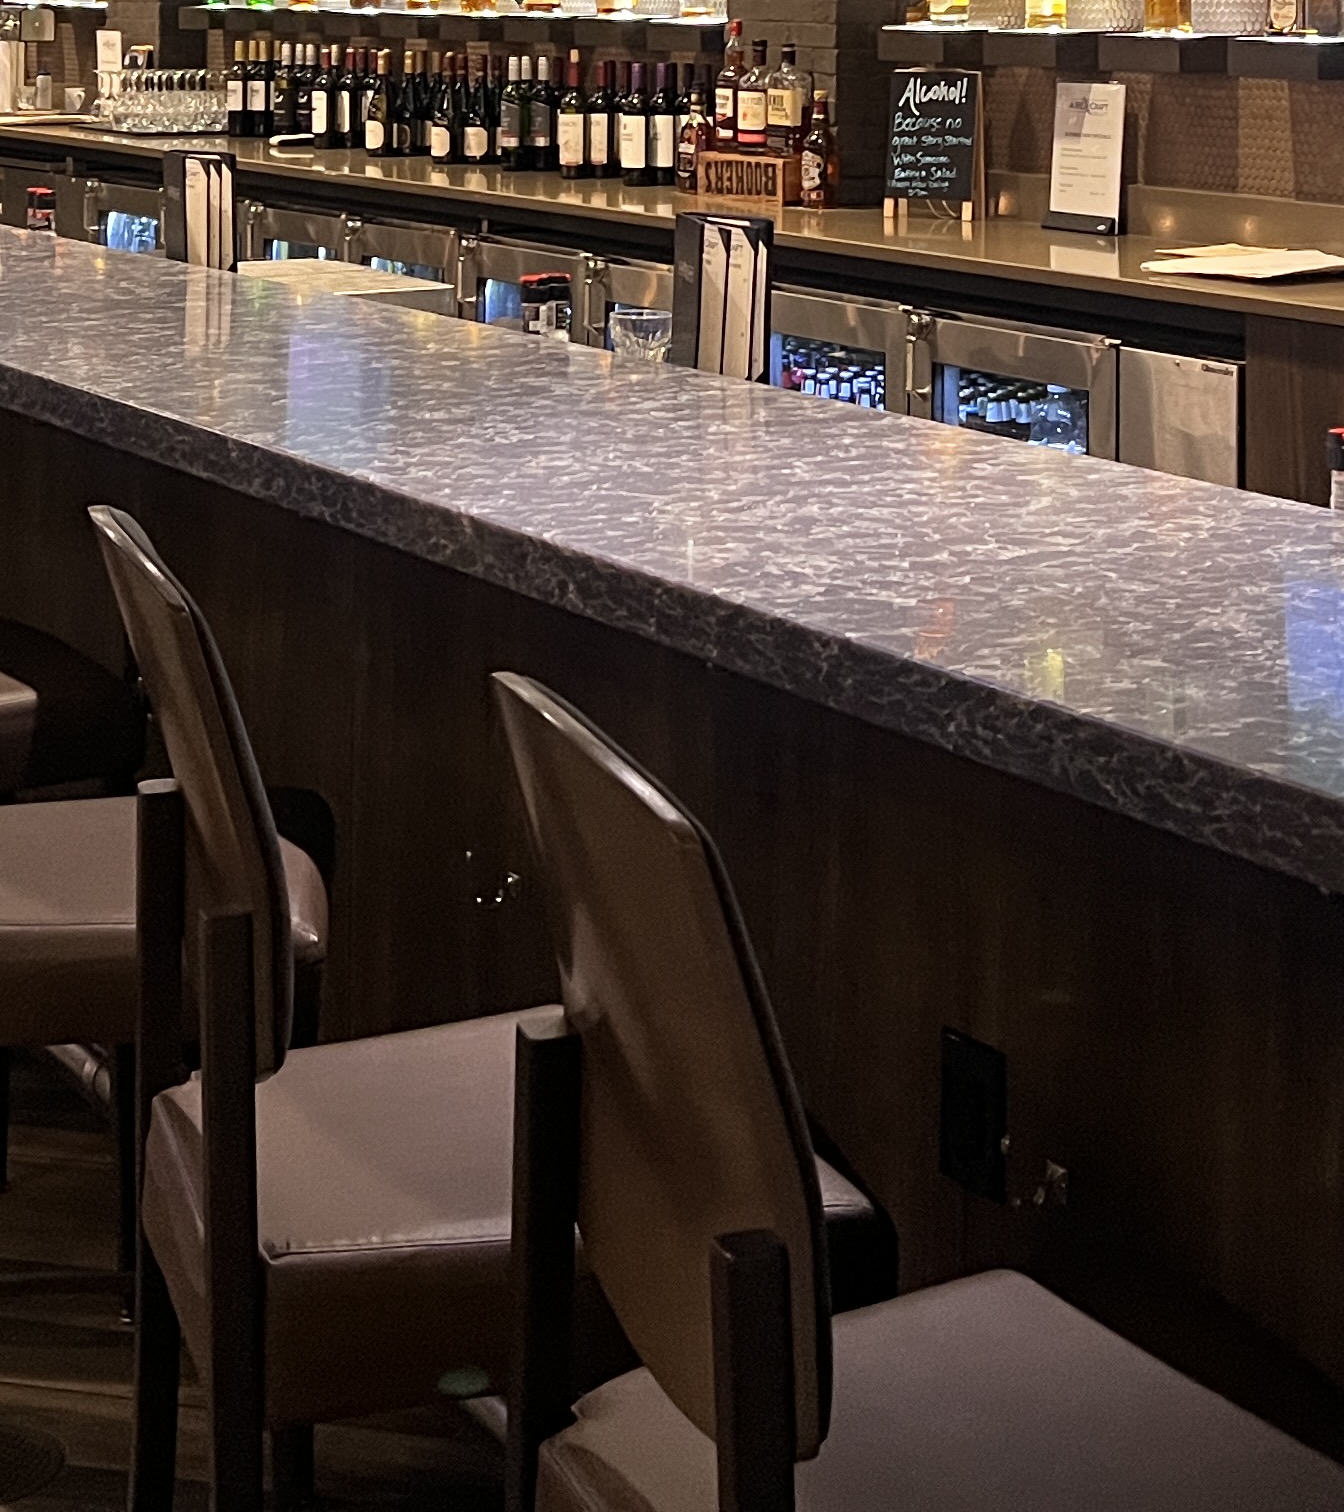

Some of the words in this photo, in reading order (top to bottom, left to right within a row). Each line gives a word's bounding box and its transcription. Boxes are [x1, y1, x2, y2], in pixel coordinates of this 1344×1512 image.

[898, 77, 968, 116] Alcohol!
[893, 112, 942, 131] Because
[945, 118, 962, 129] no
[930, 167, 957, 180] Salad
